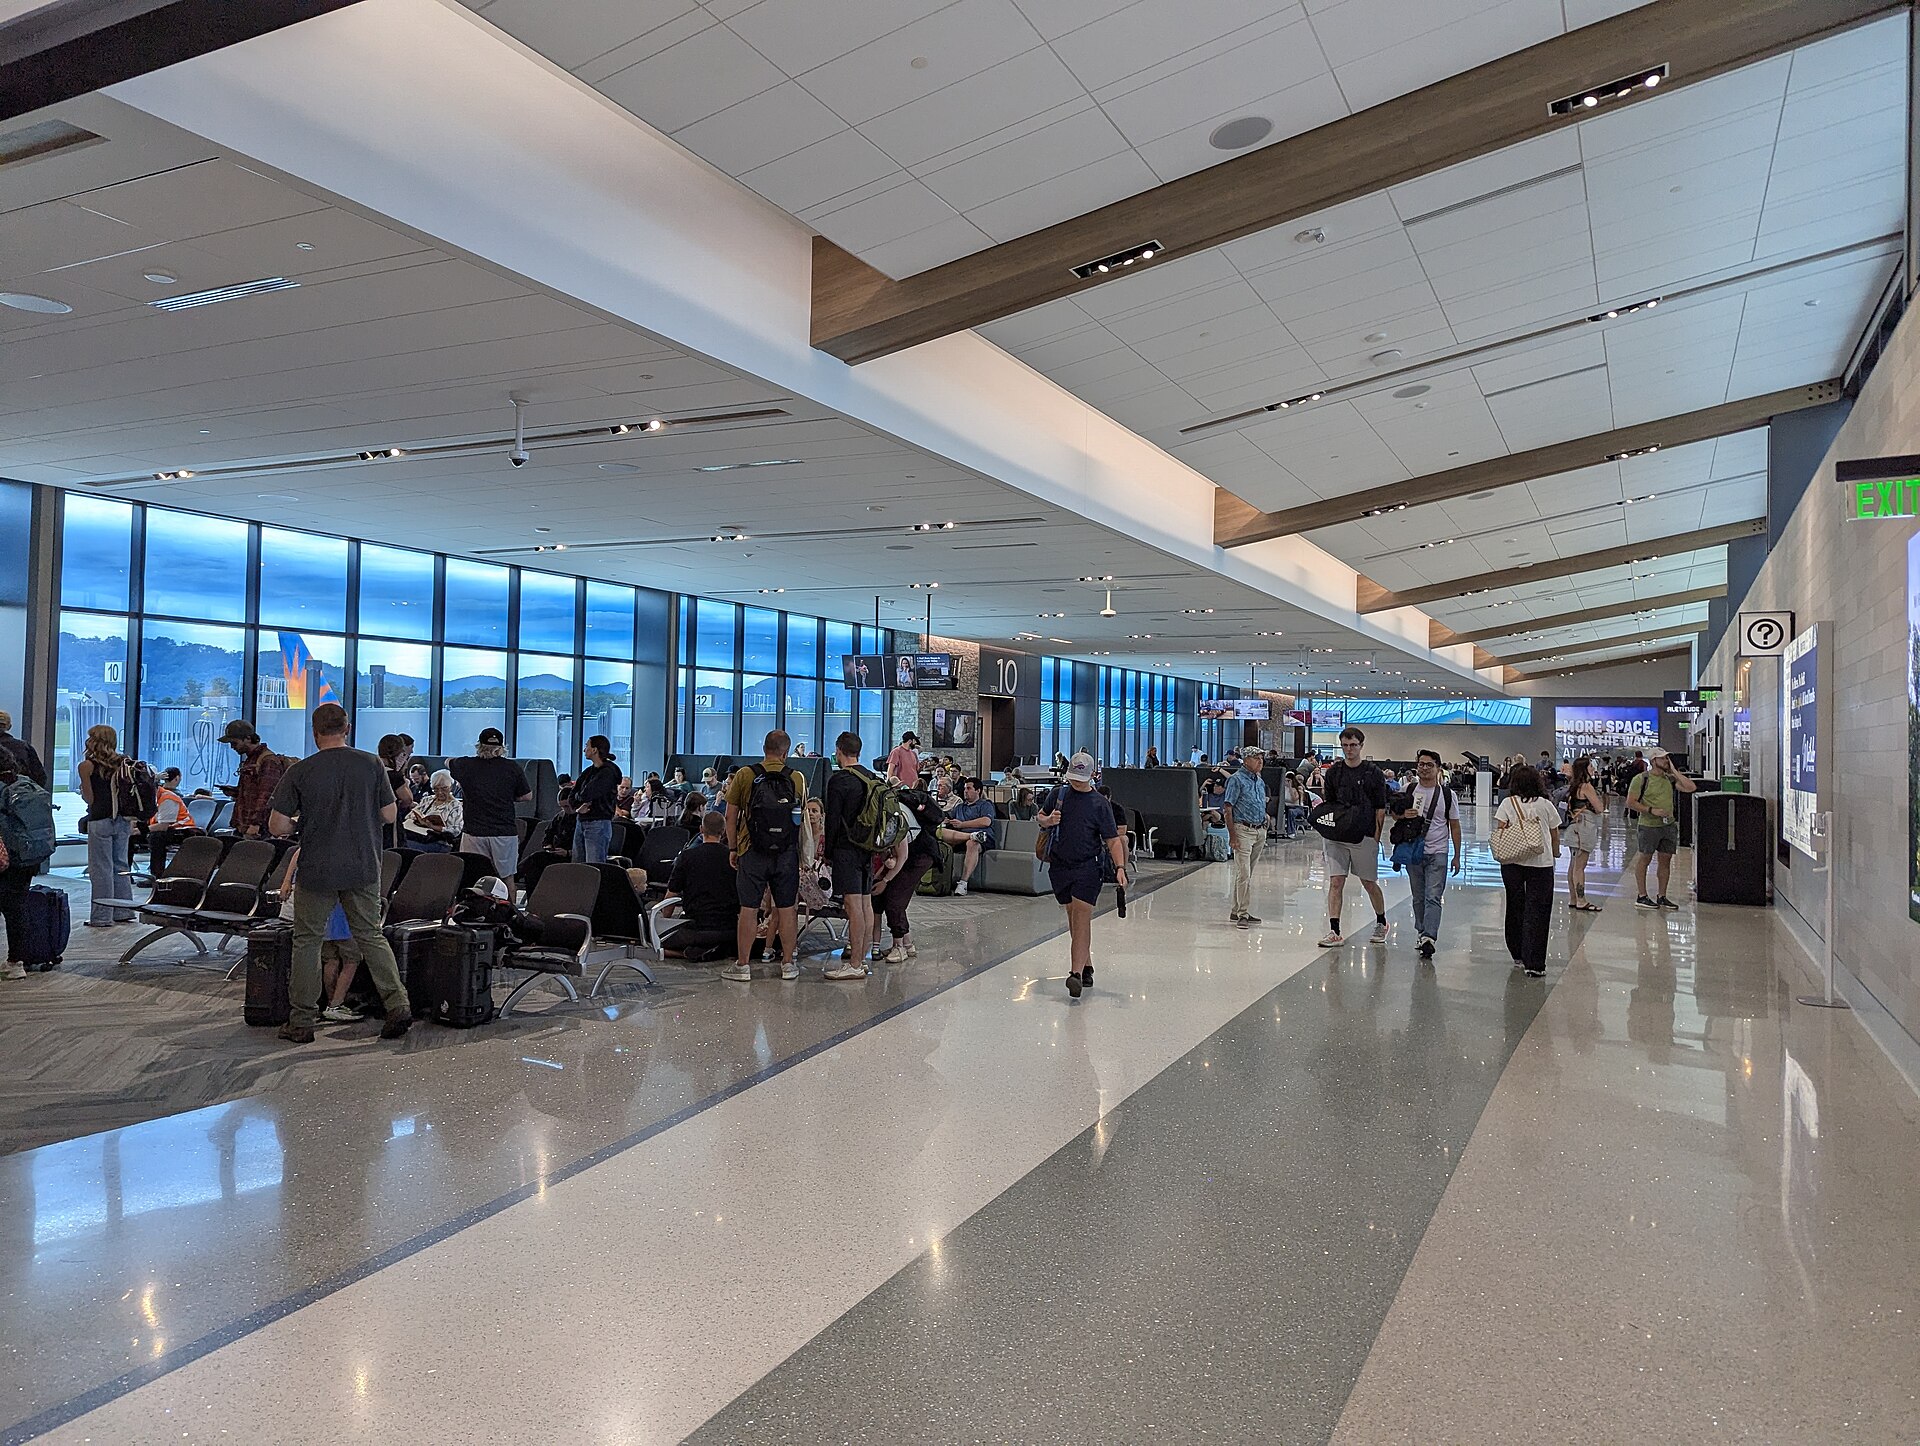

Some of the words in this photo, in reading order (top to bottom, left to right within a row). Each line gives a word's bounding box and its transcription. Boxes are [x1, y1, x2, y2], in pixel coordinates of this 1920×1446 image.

[1856, 479, 1920, 519] EXIT
[107, 663, 118, 681] 10
[996, 658, 1018, 695] 10
[696, 695, 707, 706] 12
[1563, 720, 1602, 733] MORE
[1605, 720, 1652, 734] SPACE
[1563, 735, 1575, 746] IS
[1577, 735, 1594, 746] ON
[1598, 735, 1619, 746] THE
[1622, 735, 1648, 747] WAY
[1563, 747, 1577, 758] AT
